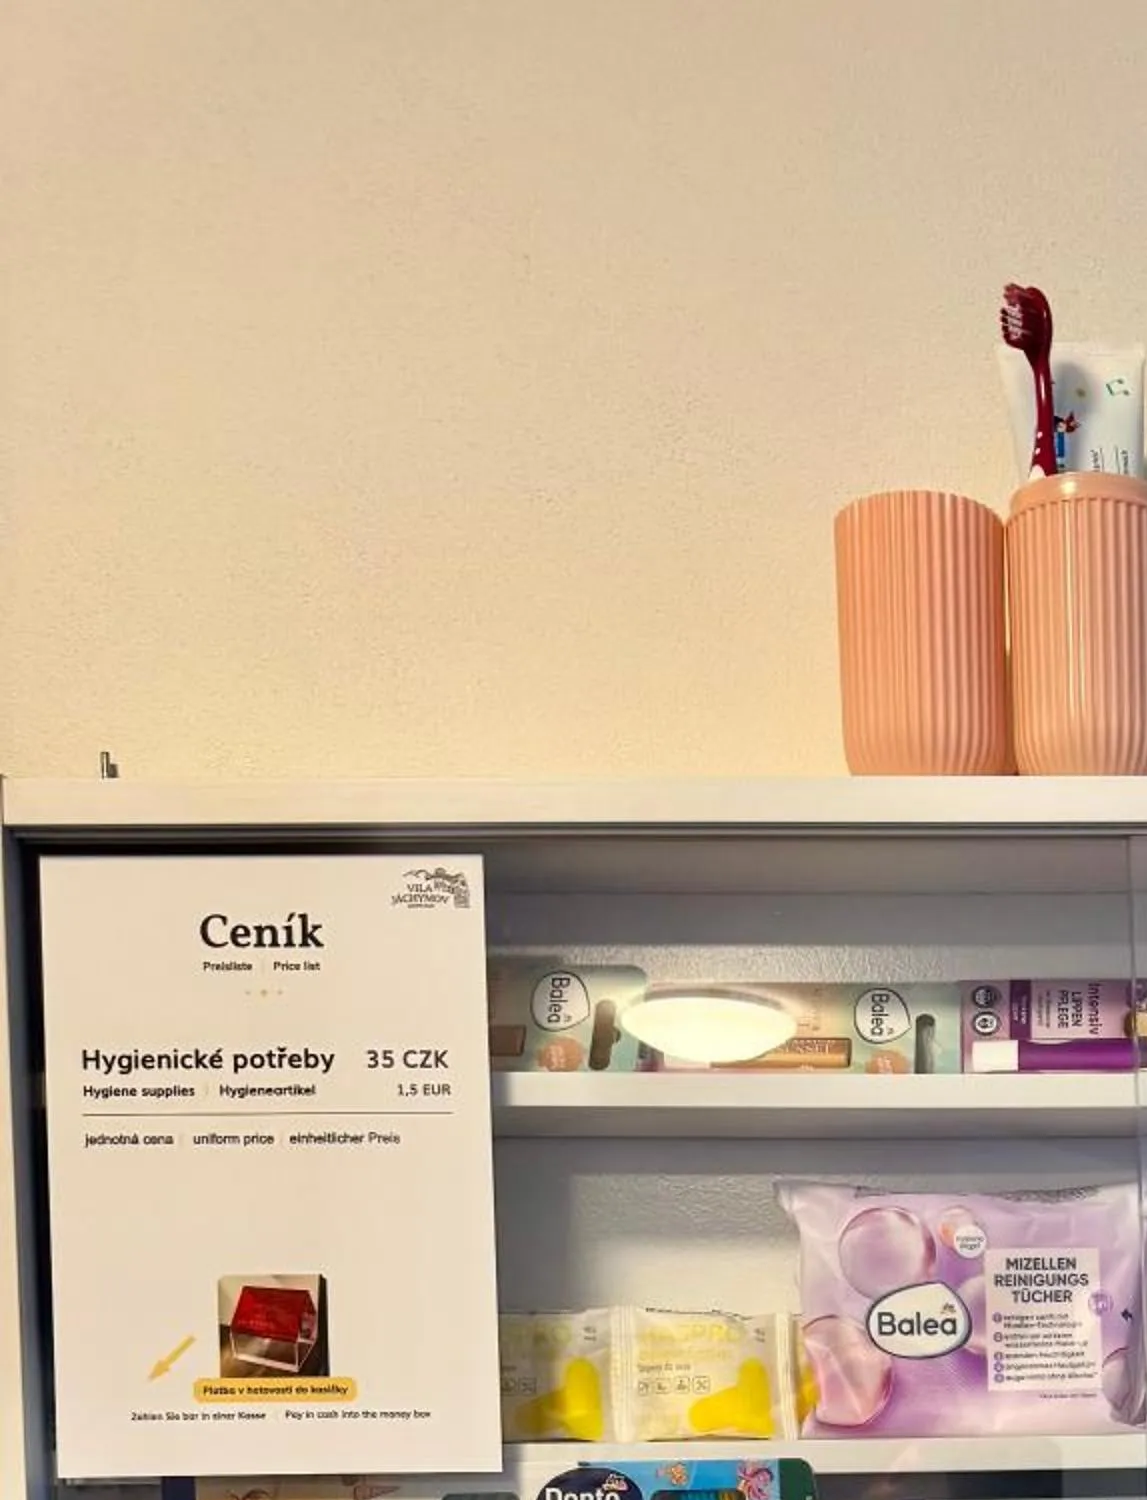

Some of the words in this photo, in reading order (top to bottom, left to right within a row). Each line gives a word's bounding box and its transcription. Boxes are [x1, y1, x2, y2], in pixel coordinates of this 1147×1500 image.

[200, 912, 324, 948] Ceník
[203, 961, 253, 971] Preisliste
[273, 962, 300, 971] Price
[303, 962, 320, 971] list
[547, 977, 571, 1024] Balea
[871, 993, 890, 1037] Balea
[82, 1048, 223, 1074] Hygienické
[233, 1048, 335, 1073] potřeby
[367, 1050, 395, 1069] 35
[403, 1050, 449, 1069] CZK
[83, 1085, 138, 1098] Hygiene
[141, 1085, 195, 1098] supplies
[220, 1084, 316, 1098] Hygieneartikel
[397, 1084, 418, 1098] 1,5
[423, 1084, 451, 1096] EUR
[85, 1133, 140, 1148] jednotná
[193, 1133, 240, 1145] uniform
[243, 1133, 274, 1148] price
[290, 1133, 364, 1144] einheitlicher
[368, 1132, 400, 1144] Preis
[1006, 1258, 1076, 1271] MIZELLEN
[994, 1274, 1089, 1287] REINIGUNGS
[1012, 1290, 1072, 1303] TÜCHER
[878, 1312, 958, 1336] Balea
